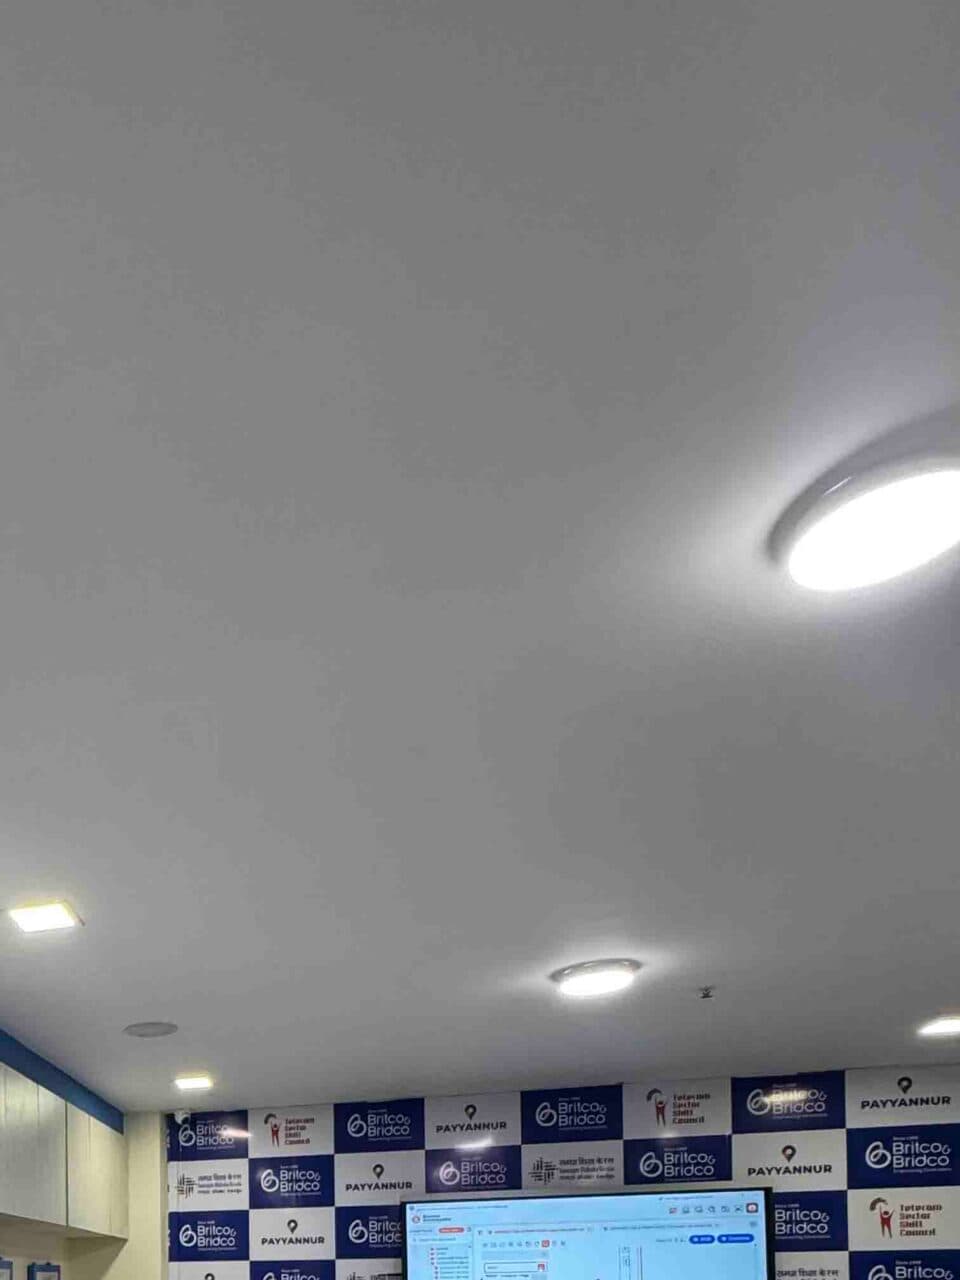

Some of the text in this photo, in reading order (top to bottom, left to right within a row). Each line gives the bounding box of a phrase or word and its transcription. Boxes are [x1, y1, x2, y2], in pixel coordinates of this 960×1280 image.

[861, 1096, 951, 1109] PAYYANNUR
[559, 1114, 605, 1126] Bridco
[368, 1125, 410, 1137] Bridco
[436, 1122, 507, 1133] PAYYANNUR
[196, 1134, 234, 1146] Bridco
[893, 1154, 950, 1168] Bridco
[664, 1164, 714, 1177] Bridco
[748, 1164, 832, 1176] PAYYANNUR
[461, 1173, 506, 1185] Bridco
[280, 1181, 320, 1192] Bridco
[345, 1182, 412, 1191] PAYYANNUR
[775, 1222, 828, 1235] Bridco
[197, 1236, 235, 1247] Bridco
[262, 1236, 325, 1245] PAYYANNUR
[369, 1230, 402, 1243] Bridc
